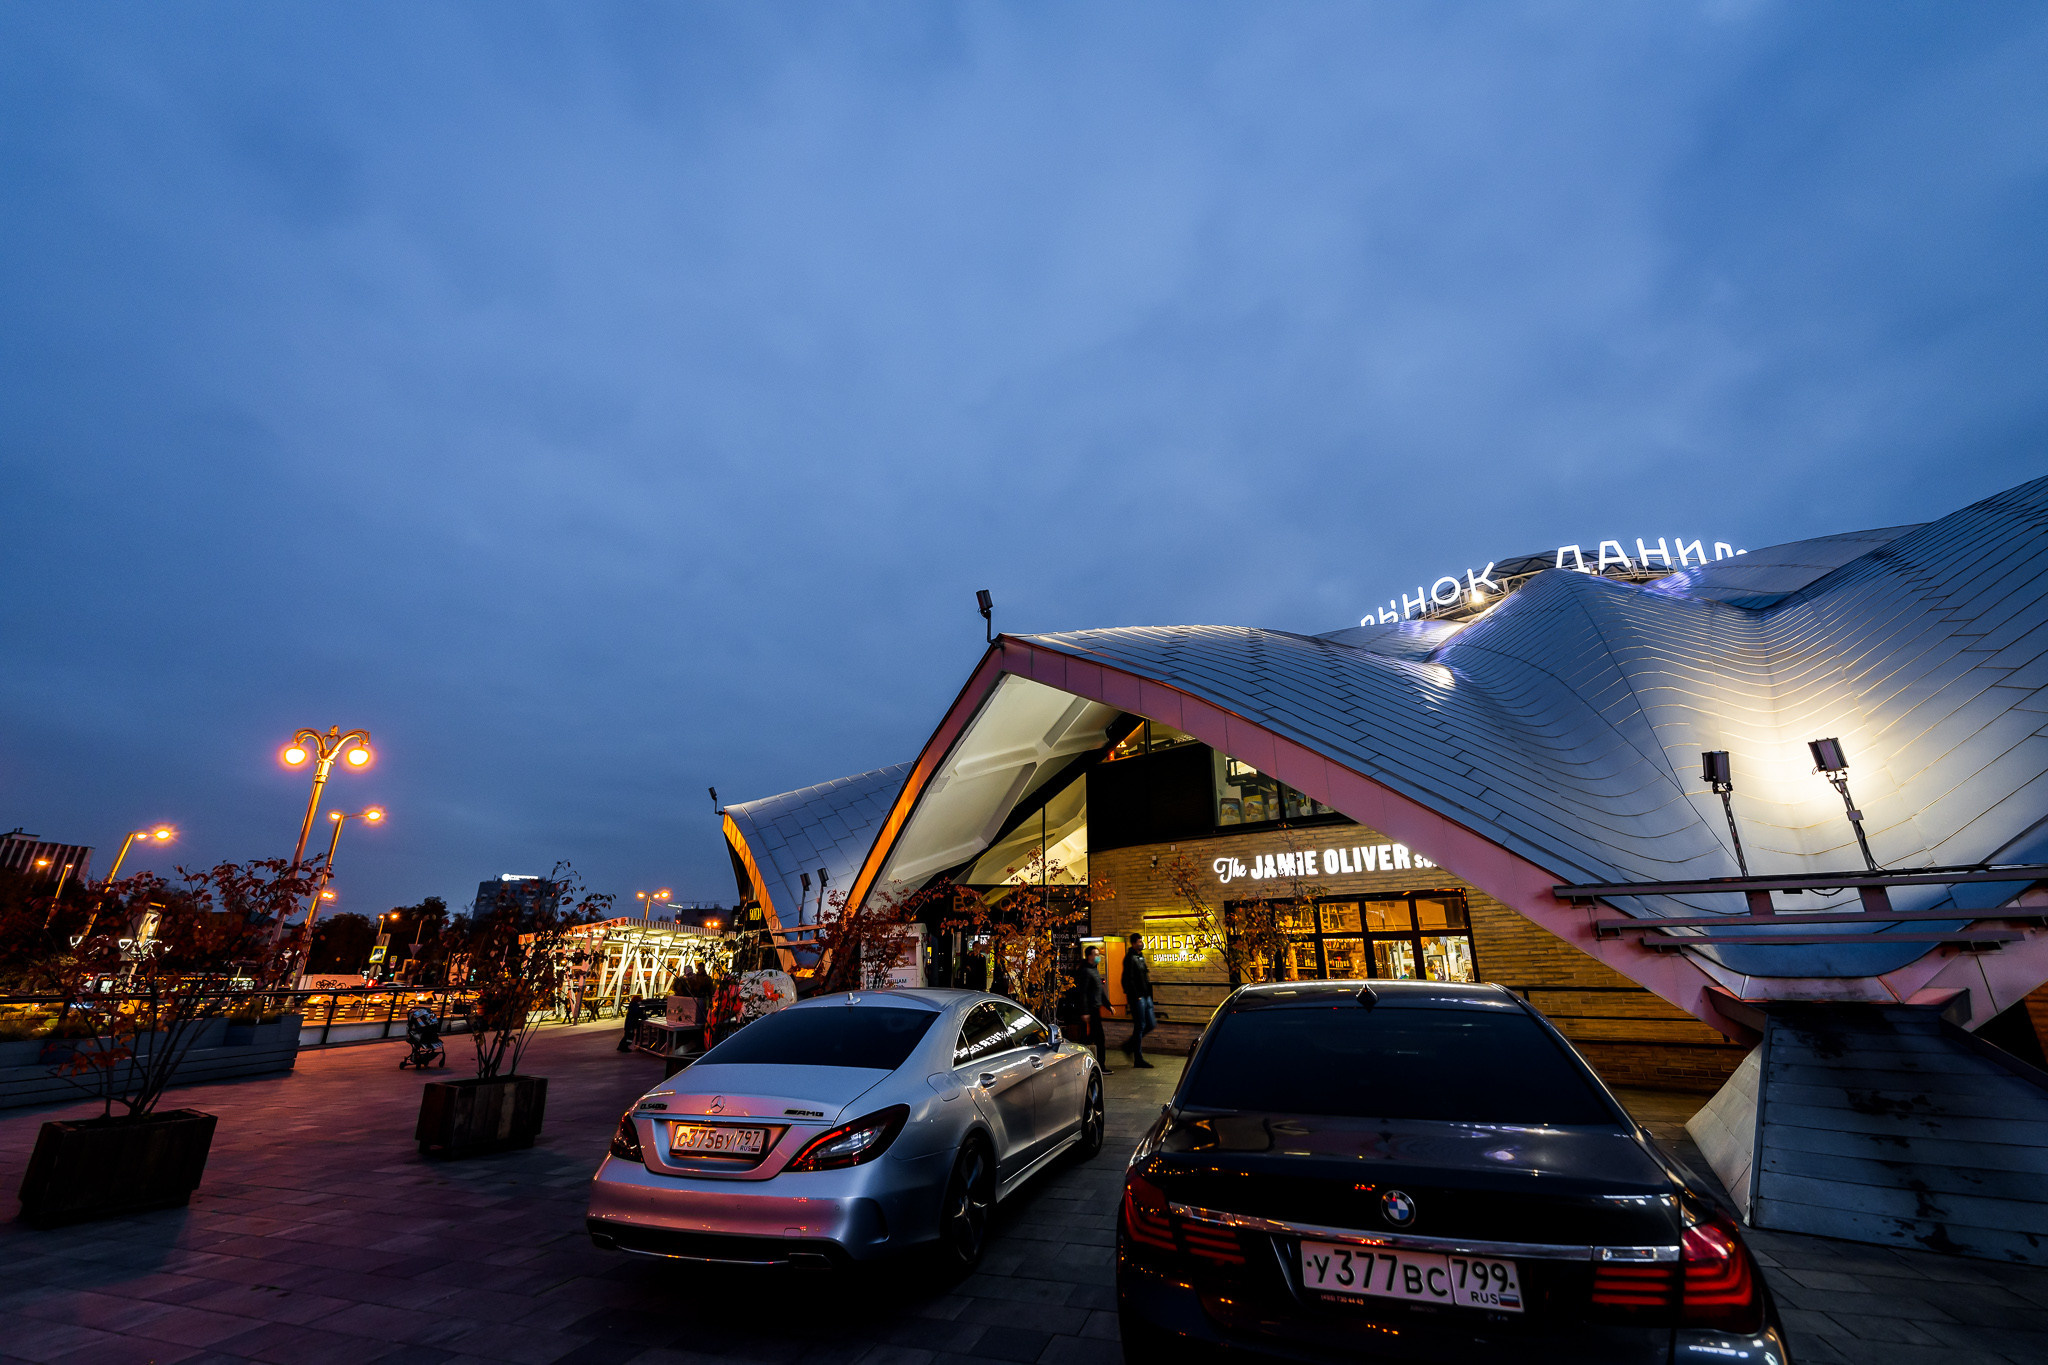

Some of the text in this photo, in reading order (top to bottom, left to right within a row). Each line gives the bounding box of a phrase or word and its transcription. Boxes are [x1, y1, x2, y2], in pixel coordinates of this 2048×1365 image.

[1555, 537, 1748, 574] ДАНИЛ
[1213, 857, 1247, 883] The
[1250, 850, 1319, 880] JAMIE
[1323, 843, 1412, 875] OLIVER
[1153, 952, 1187, 962] ВИННЫЙ
[678, 1128, 760, 1149] С375ВУ 797
[1313, 1249, 1509, 1297] У377ВС 799
[1471, 1291, 1499, 1305] RUS
